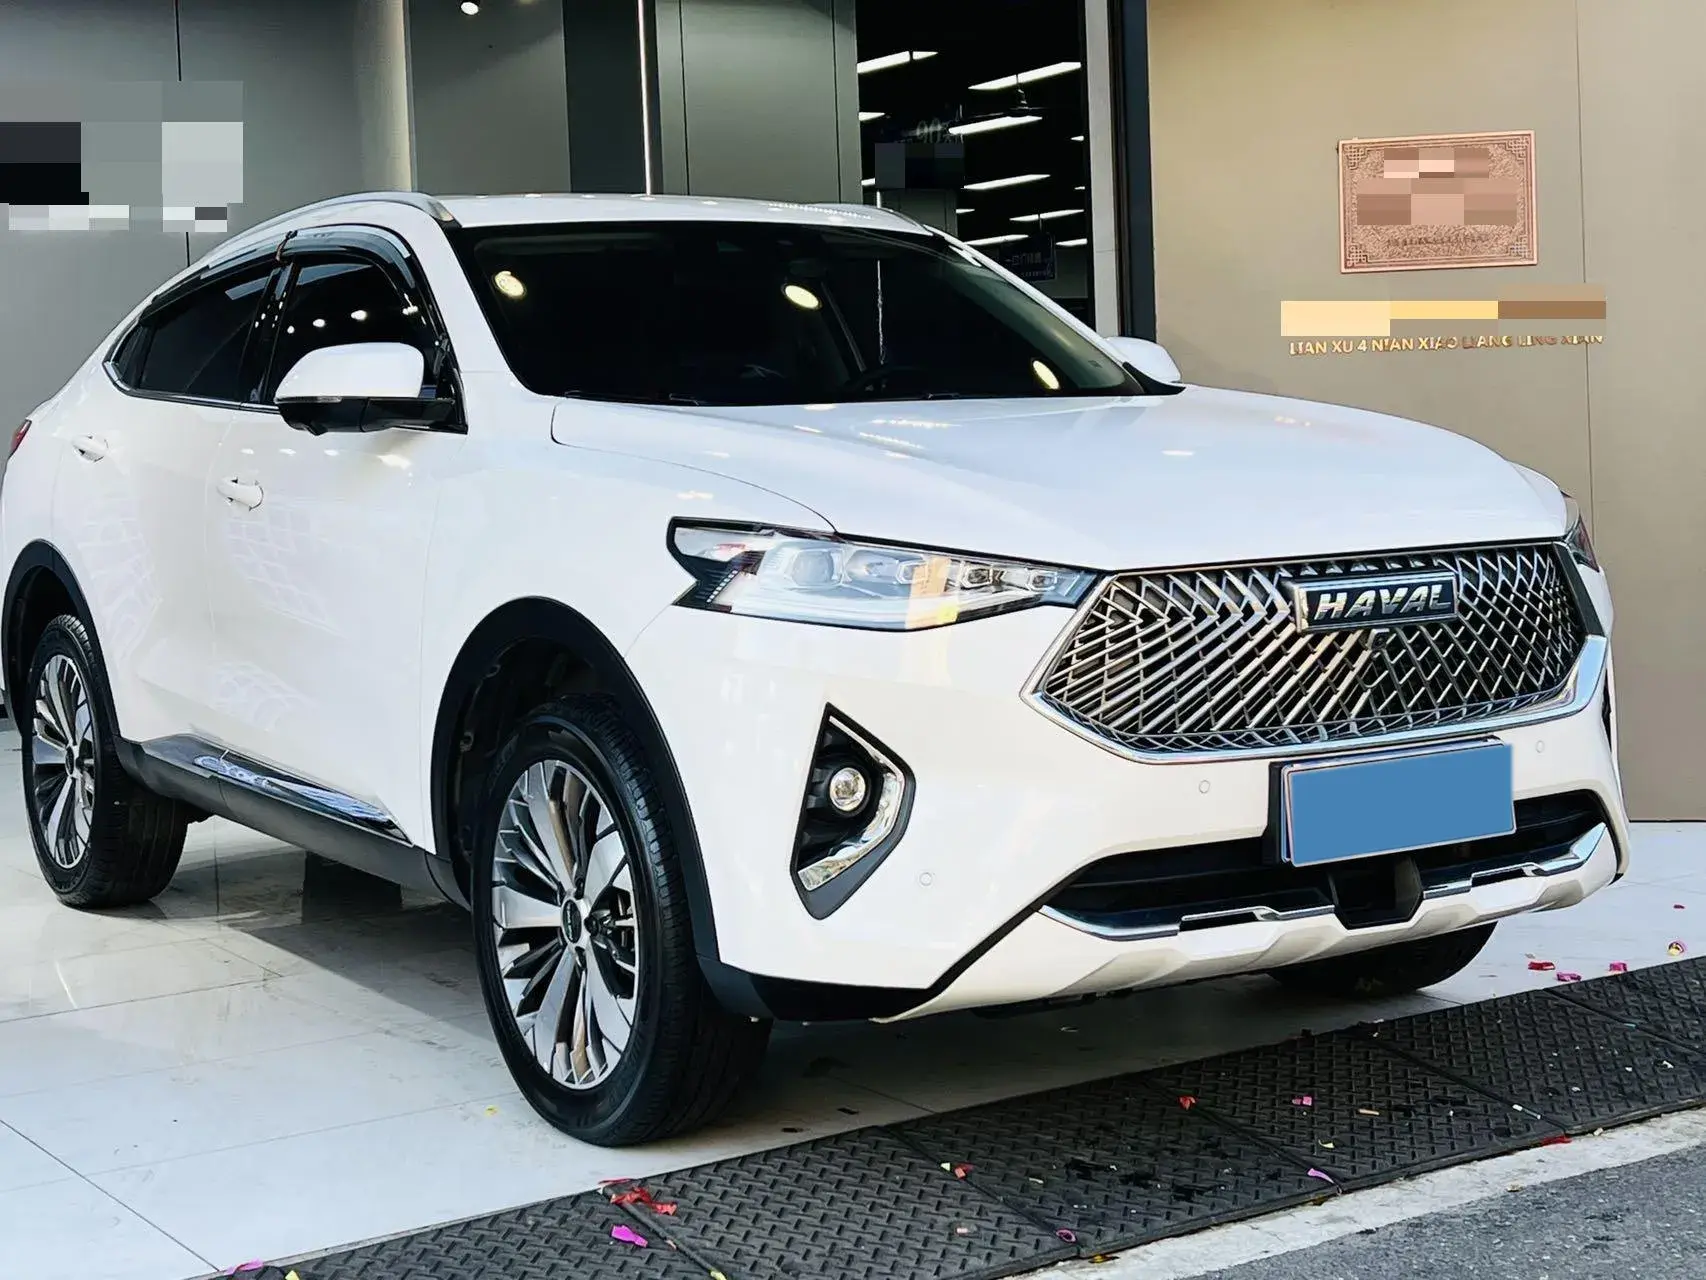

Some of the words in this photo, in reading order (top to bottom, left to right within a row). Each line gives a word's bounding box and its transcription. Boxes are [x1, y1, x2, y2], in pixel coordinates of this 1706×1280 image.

[1290, 340, 1327, 355] LIAN
[1332, 339, 1354, 353] XU
[1357, 339, 1368, 352] 4
[1372, 337, 1414, 352] NIAN
[1313, 584, 1451, 620] HAVAL
